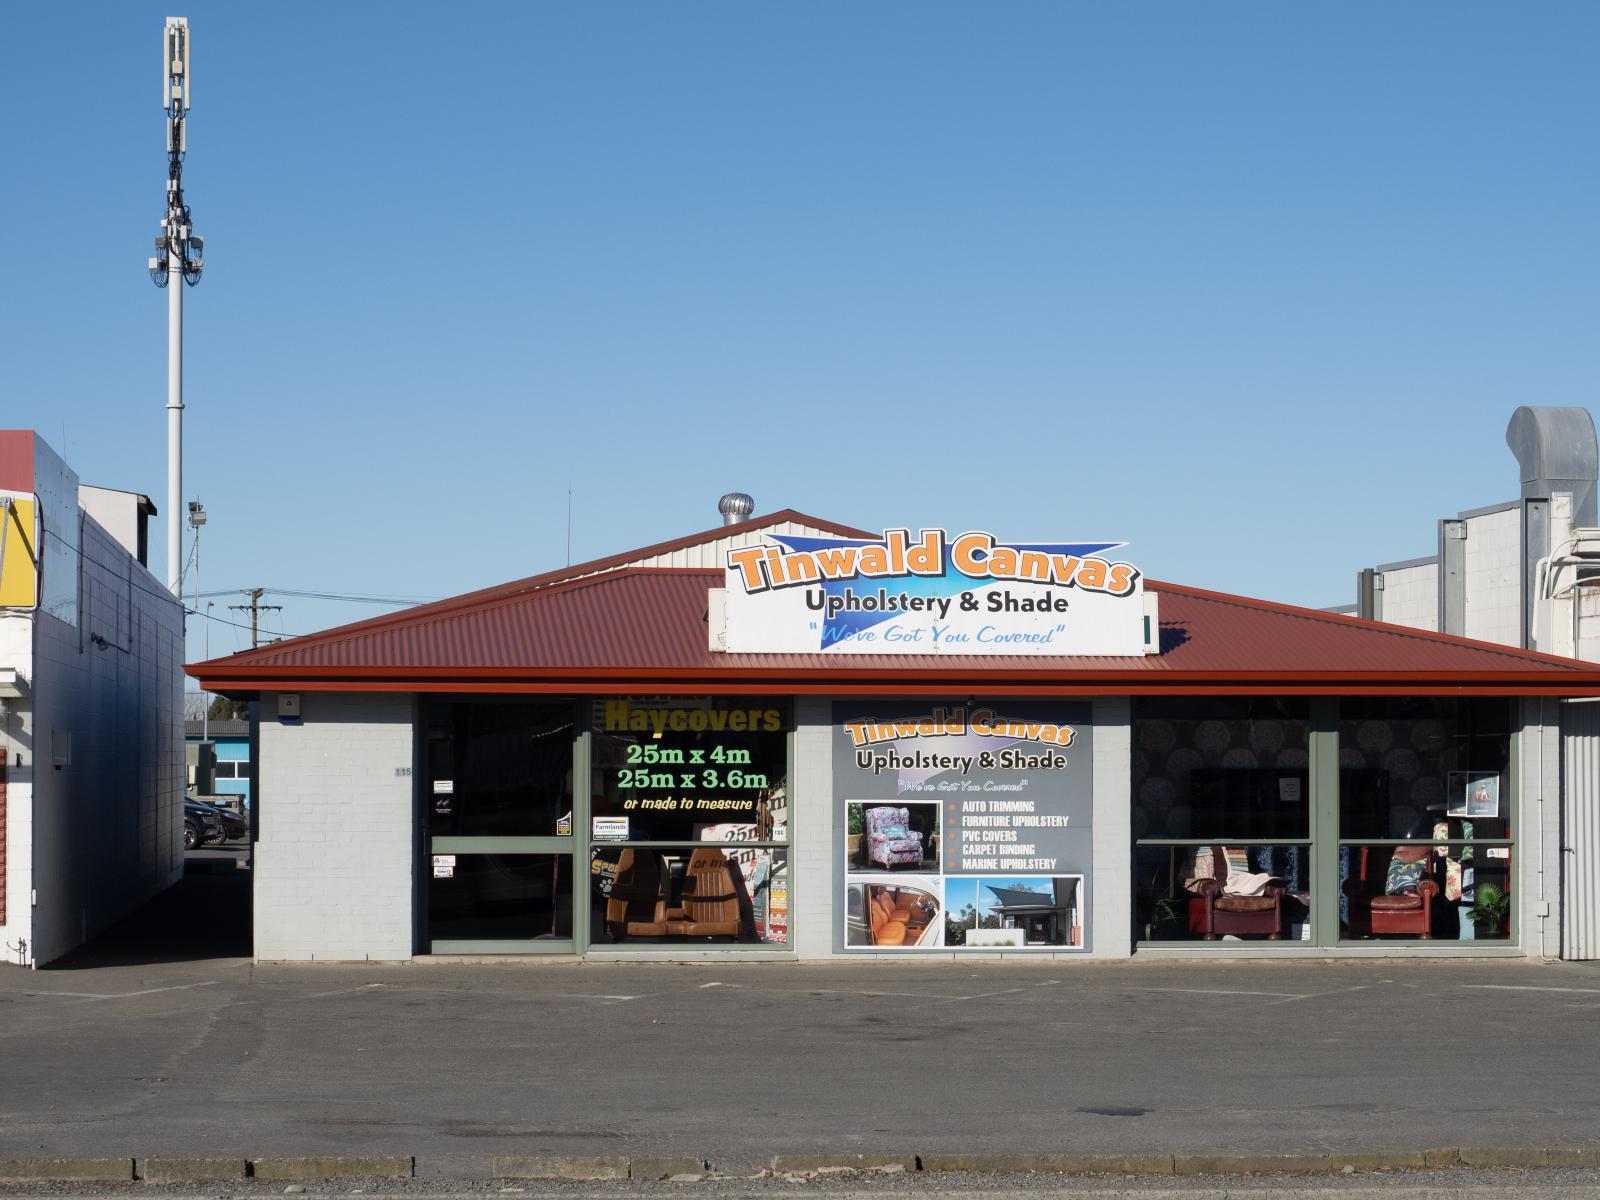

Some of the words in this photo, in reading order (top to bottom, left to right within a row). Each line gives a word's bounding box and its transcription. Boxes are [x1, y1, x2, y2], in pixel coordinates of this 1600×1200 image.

[728, 529, 947, 592] Tinwald
[951, 531, 1140, 597] Canvas
[806, 590, 951, 618] Upholstery
[960, 592, 979, 612] &
[987, 592, 1069, 612] Shade
[884, 625, 928, 643] Got
[931, 625, 970, 643] You
[977, 624, 1066, 644] Covered"
[606, 700, 781, 738] Haycovers
[845, 707, 967, 747] Tinwald
[968, 708, 1076, 747] Canvas
[627, 745, 684, 764] 25m
[690, 750, 705, 764] x
[710, 745, 751, 764] 4m
[857, 750, 972, 774] Upholstery
[979, 751, 995, 769] &
[1000, 750, 1066, 769] Shade
[618, 769, 675, 788] 25m
[681, 774, 695, 788] x
[703, 770, 768, 789] 3.6m
[624, 800, 638, 809] or
[641, 796, 677, 810] made
[680, 797, 694, 809] to
[697, 799, 753, 810] measure
[962, 801, 987, 812] AUTO
[988, 801, 1035, 812] TRIMMING
[962, 816, 1010, 827] FURNITURE
[1012, 816, 1069, 827] UPHOLSTERY
[962, 831, 981, 842] PVC
[983, 831, 1017, 842] COVERS
[962, 844, 997, 855] CARPET
[999, 844, 1035, 855] BINDING
[962, 859, 999, 870] MARINE
[1000, 859, 1057, 870] UPHOLSTERY
